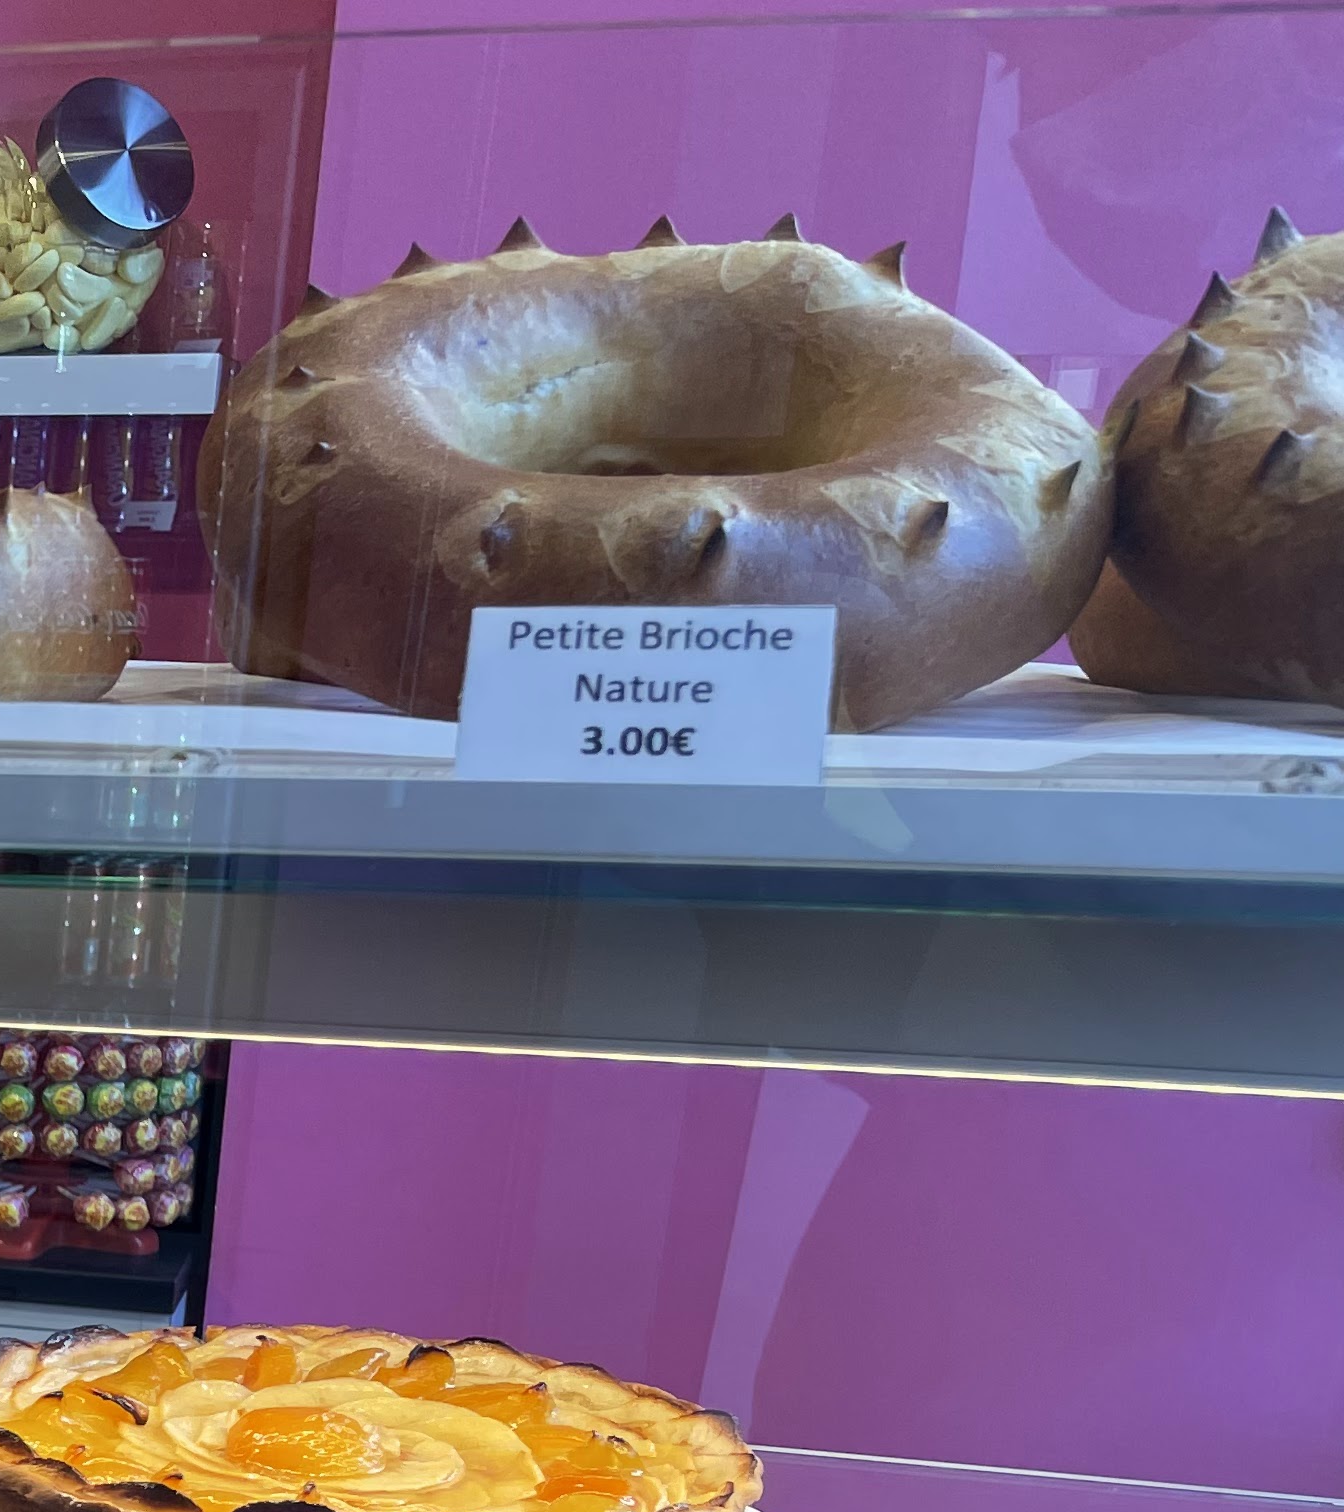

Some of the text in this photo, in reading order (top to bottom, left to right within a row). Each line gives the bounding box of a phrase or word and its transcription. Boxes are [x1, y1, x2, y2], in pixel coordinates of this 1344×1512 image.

[509, 619, 793, 650] Petite Brioche
[574, 673, 713, 703] Nature
[580, 726, 696, 756] 3.00€
